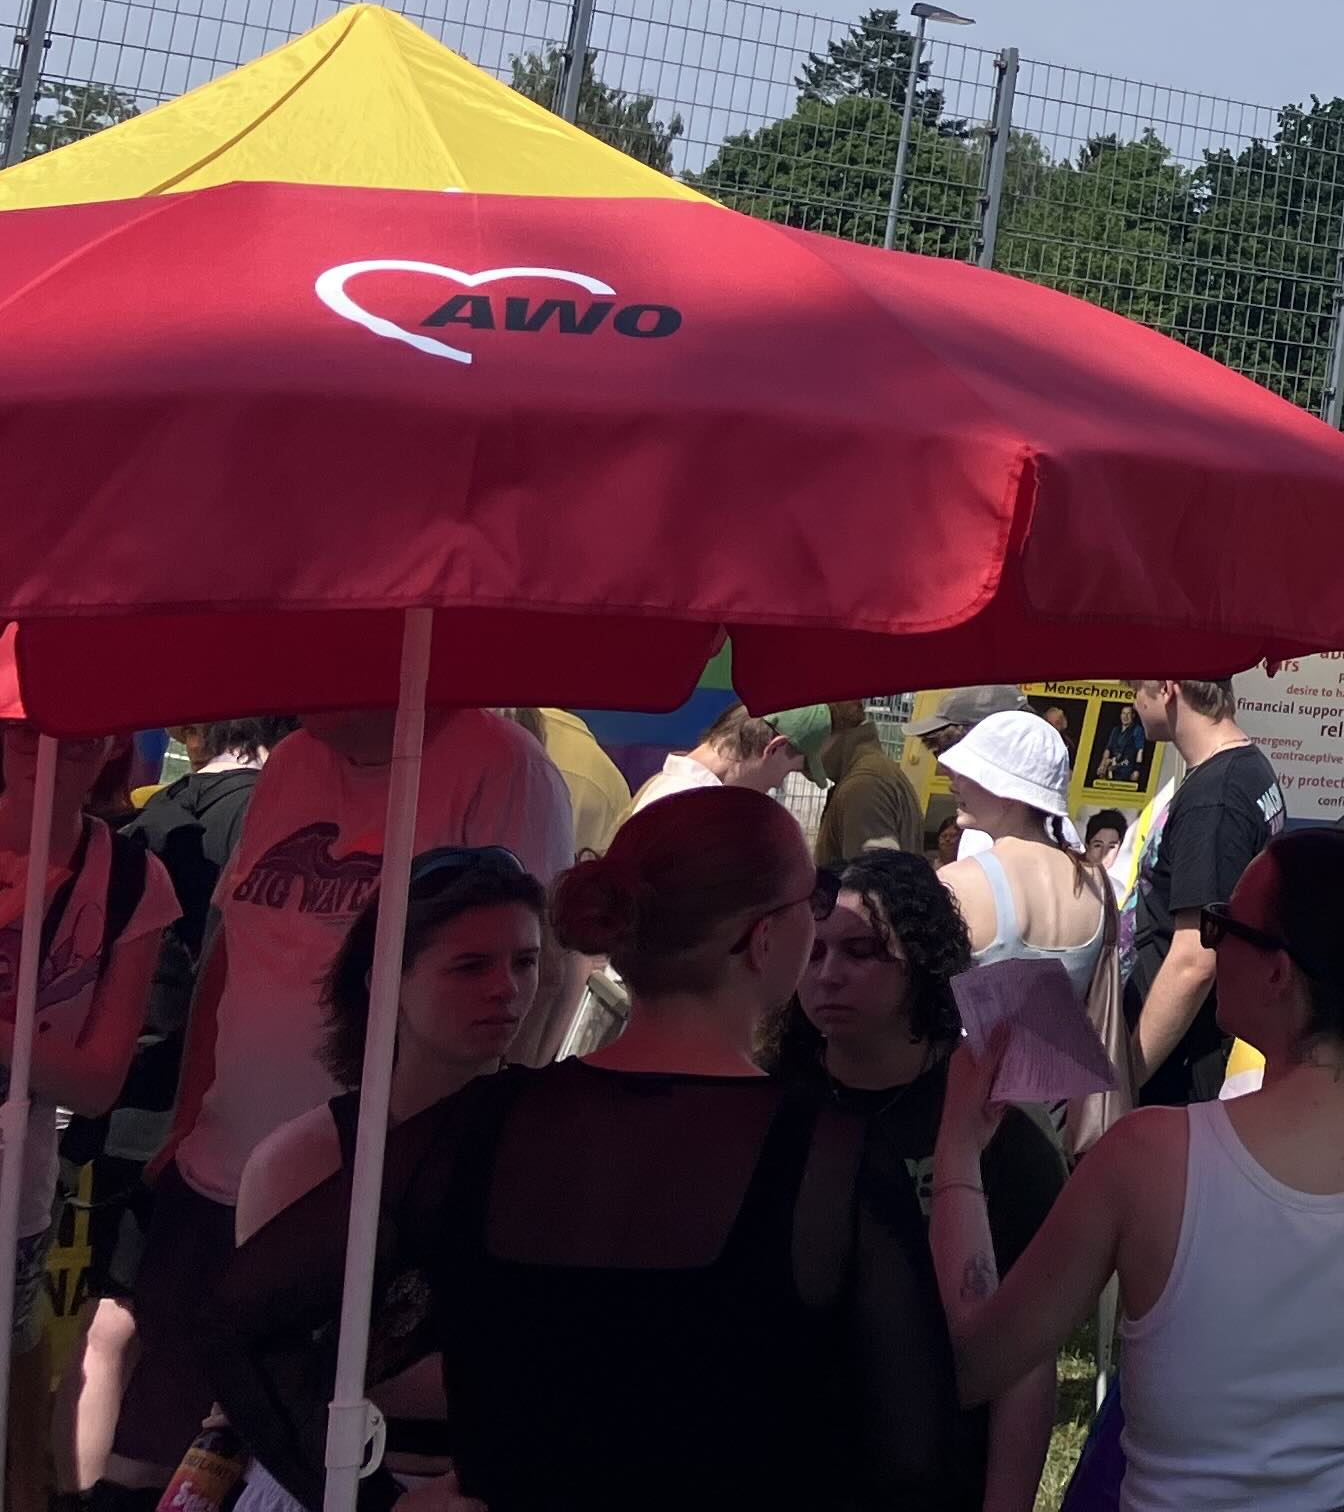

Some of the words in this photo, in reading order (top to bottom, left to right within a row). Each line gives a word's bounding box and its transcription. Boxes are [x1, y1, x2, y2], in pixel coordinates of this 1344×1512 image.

[420, 293, 684, 339] AWO
[1286, 684, 1318, 697] desire
[1321, 687, 1333, 697] to
[1237, 697, 1294, 714] financial
[1249, 736, 1303, 750] mergency
[1270, 750, 1343, 765] contraceptive
